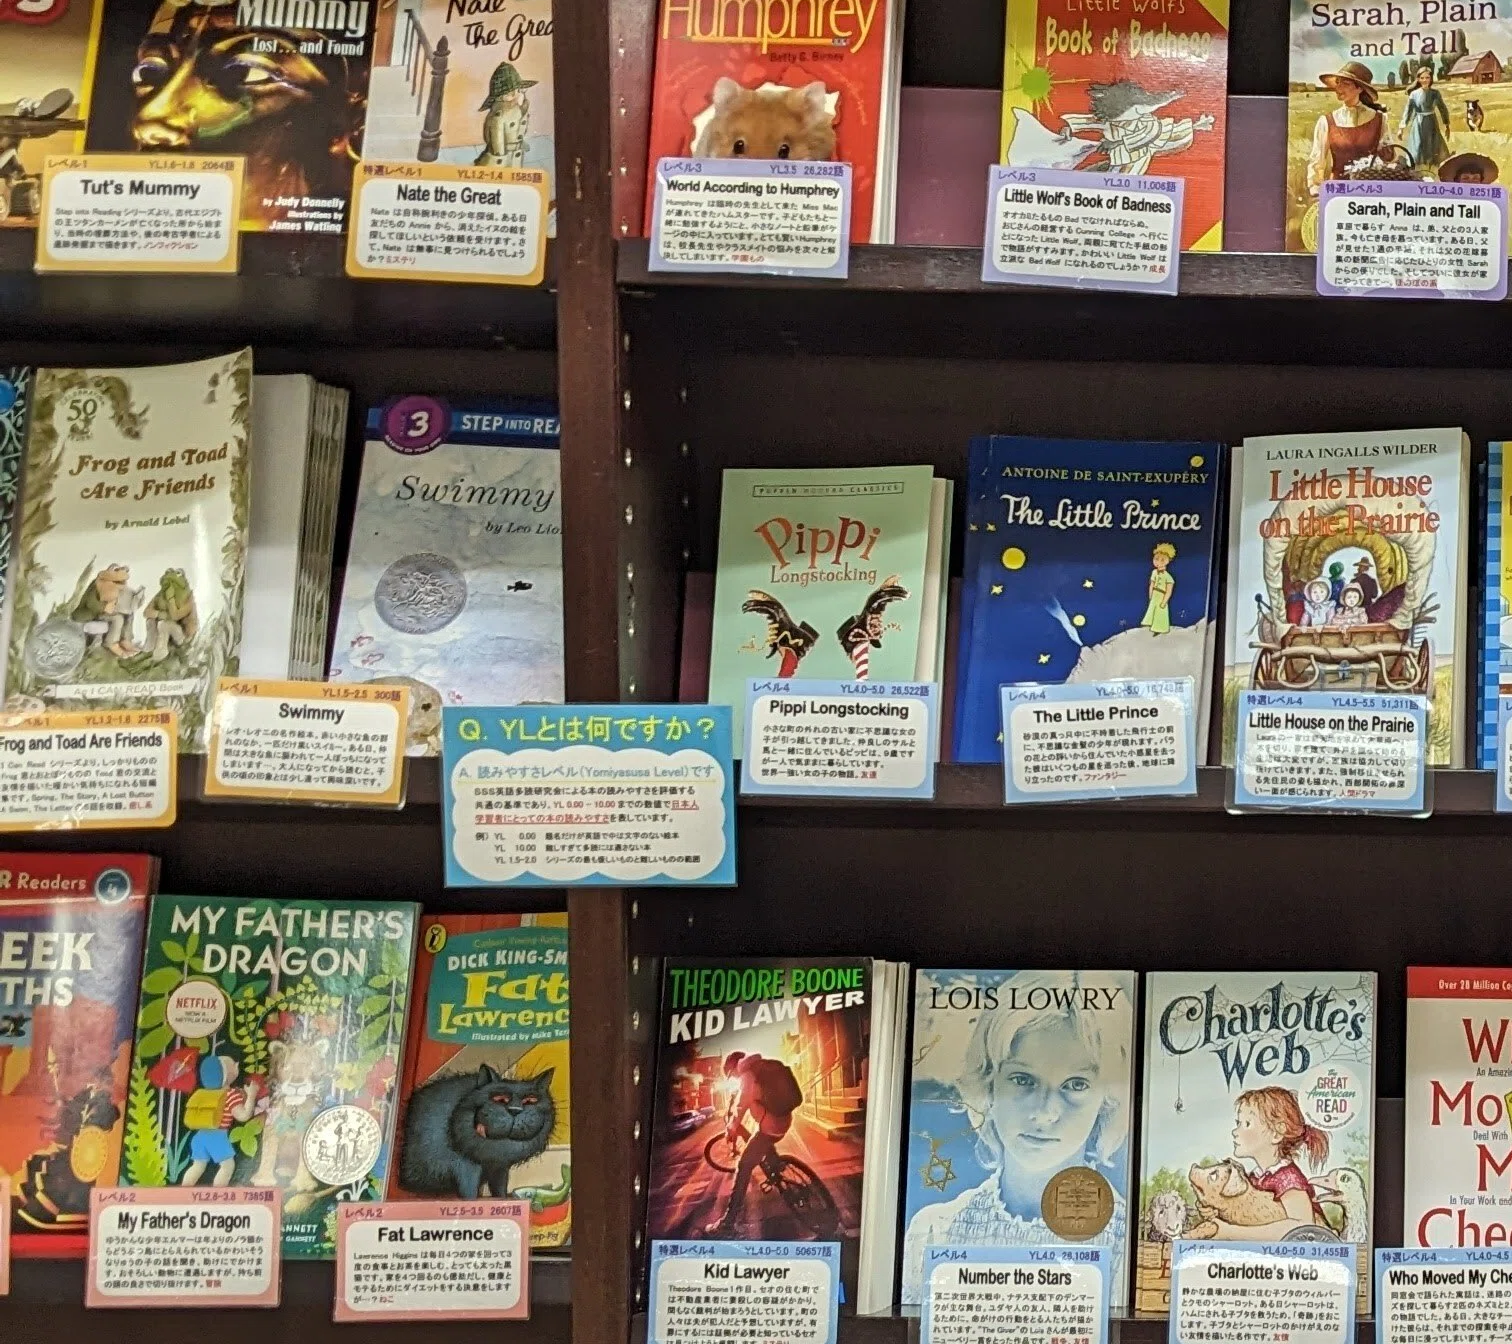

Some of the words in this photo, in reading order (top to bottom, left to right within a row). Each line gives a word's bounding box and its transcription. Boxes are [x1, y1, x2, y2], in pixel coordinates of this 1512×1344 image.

[1311, 3, 1412, 29] Sarah,
[1350, 36, 1395, 57] and
[1401, 30, 1458, 56] Tall
[397, 186, 429, 202] Nate
[433, 187, 458, 203] the
[461, 187, 502, 205] Great
[69, 453, 133, 478] Frog
[138, 453, 174, 474] and
[179, 442, 229, 469] Toad
[1266, 447, 1313, 461] LAURA
[1318, 445, 1378, 459] INGALLS
[1381, 443, 1438, 457] WILDER
[81, 477, 128, 501] Are
[135, 472, 216, 502] Friends
[105, 519, 118, 530] by
[122, 517, 159, 529] Arnold
[162, 514, 190, 526] Lobel
[770, 563, 878, 586] Longstocking
[278, 704, 344, 724] Swimmy
[769, 700, 807, 717] Pippi
[810, 701, 909, 719] Longstocking
[457, 717, 488, 742] Q.
[170, 907, 226, 940] MY
[235, 906, 404, 941] FATHER'S
[202, 944, 367, 977] DRAGON
[1439, 980, 1456, 990] Over
[1459, 980, 1469, 990] 28
[1472, 980, 1499, 990] Million
[176, 995, 218, 1011] NETFLIX
[1159, 980, 1367, 1058] Charlotte's
[1214, 1032, 1312, 1088] Web
[377, 1226, 405, 1242] Fat
[408, 1226, 494, 1242] Lawrence
[958, 1268, 1006, 1285] Number
[1010, 1268, 1033, 1285] the
[1037, 1269, 1072, 1287] Stars
[1389, 1271, 1415, 1287] Who
[1418, 1270, 1465, 1286] Moved
[1468, 1269, 1487, 1289] My
